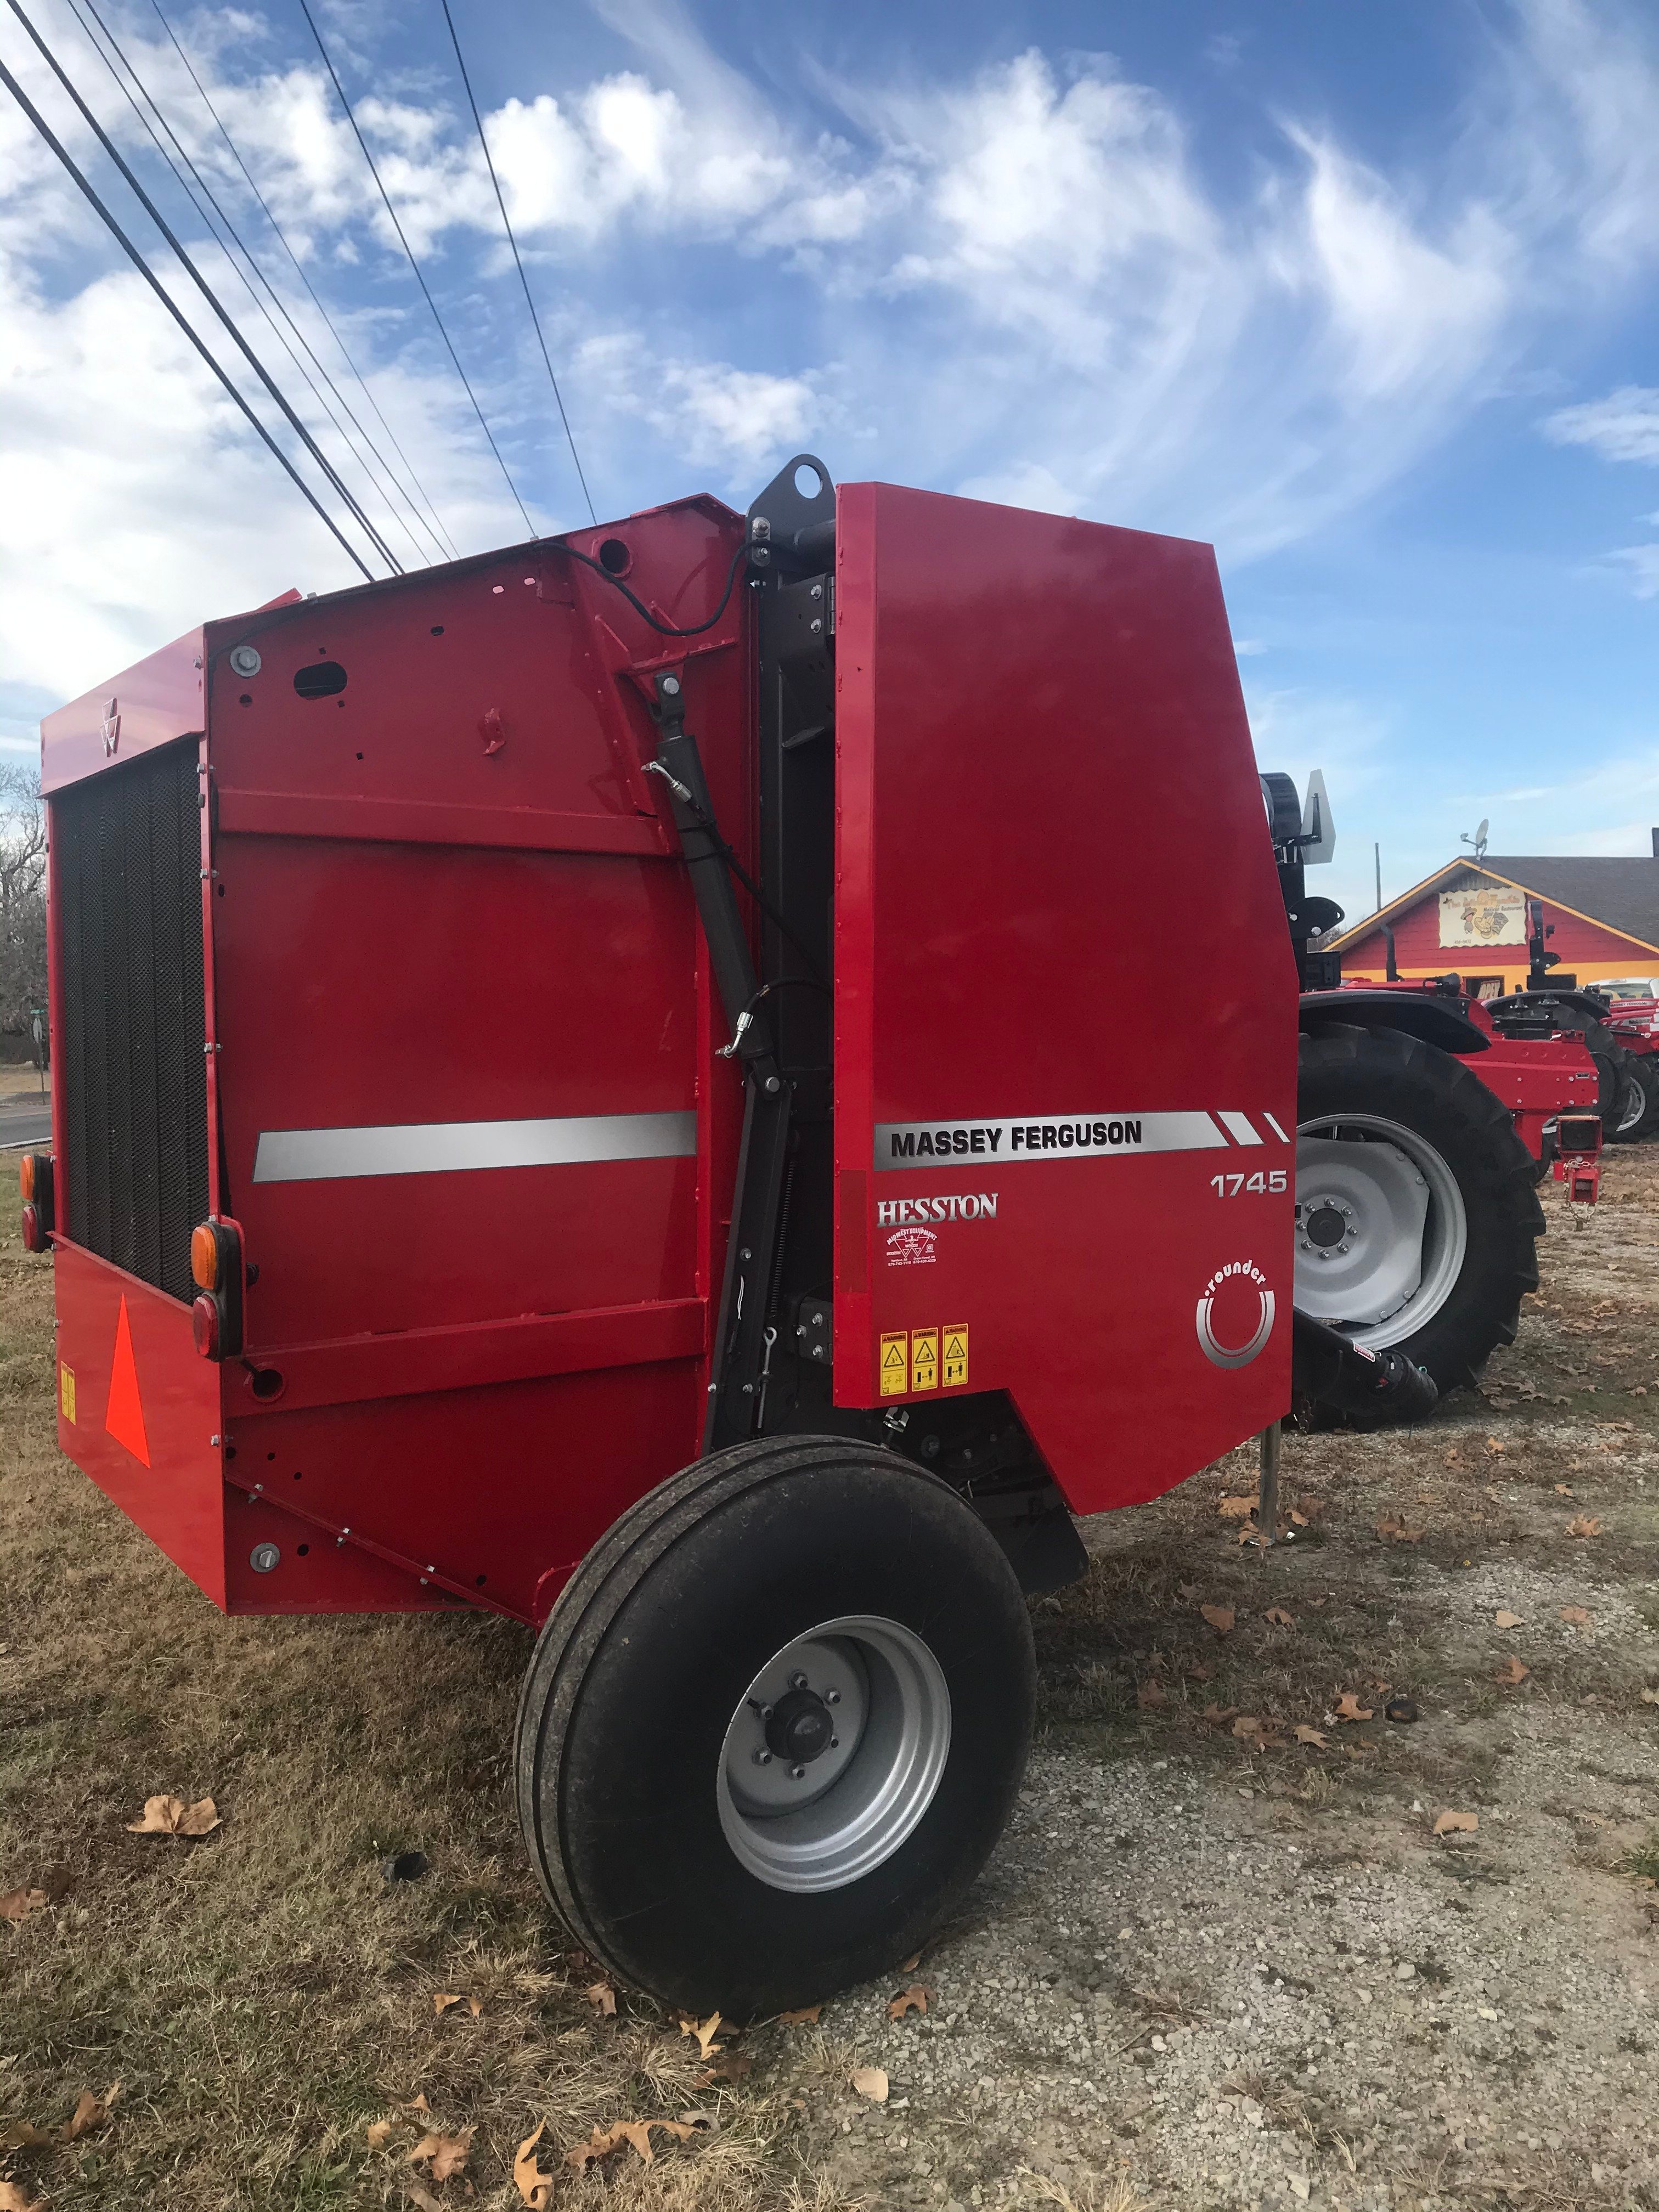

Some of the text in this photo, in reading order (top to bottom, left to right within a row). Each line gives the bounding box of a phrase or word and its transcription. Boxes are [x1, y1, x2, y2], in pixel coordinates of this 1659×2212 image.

[891, 1120, 1142, 1158] MASSEY FERGUSON
[1210, 1171, 1287, 1198] 1745
[877, 1193, 998, 1228] HESSTON
[887, 1227, 938, 1245] MIDWEST EQUIPMENT
